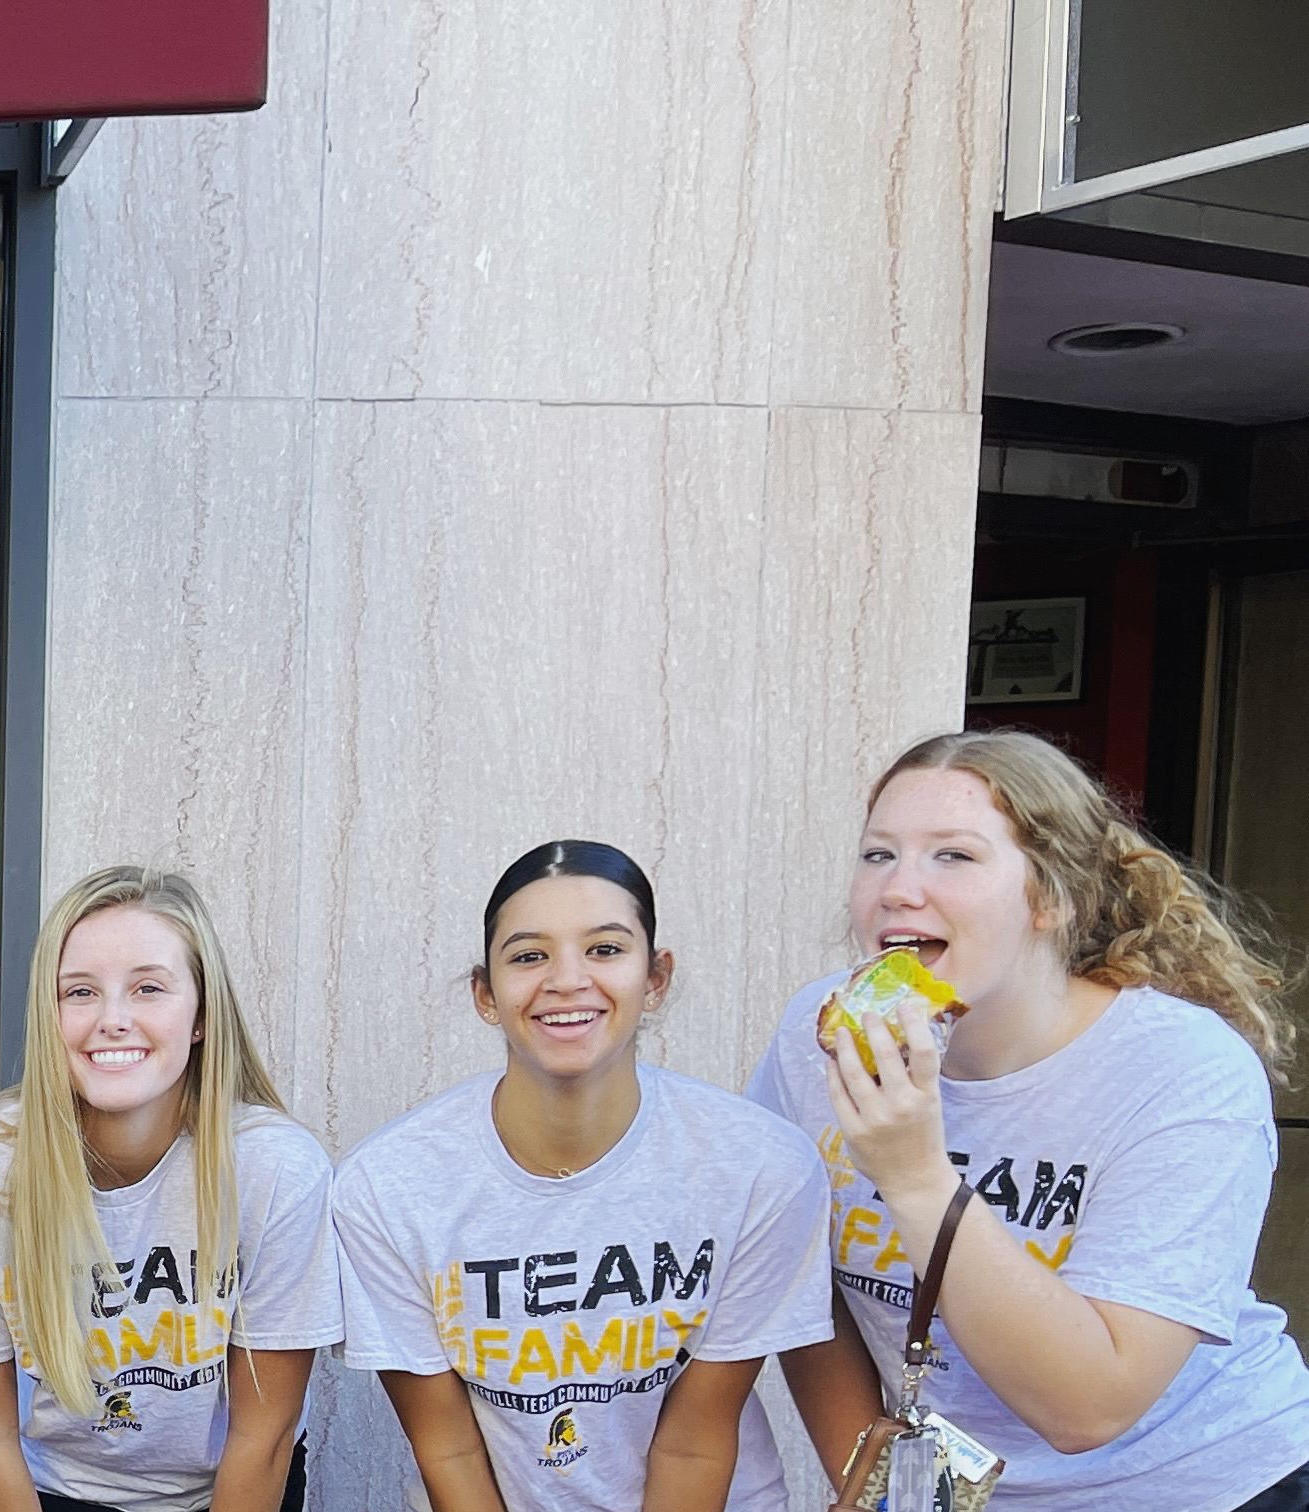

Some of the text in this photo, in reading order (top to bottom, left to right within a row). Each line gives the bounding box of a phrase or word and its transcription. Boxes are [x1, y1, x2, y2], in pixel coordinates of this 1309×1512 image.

[463, 1237, 715, 1320] TEAM
[472, 1308, 709, 1386] FAMILY
[536, 1446, 588, 1467] TROJANS
